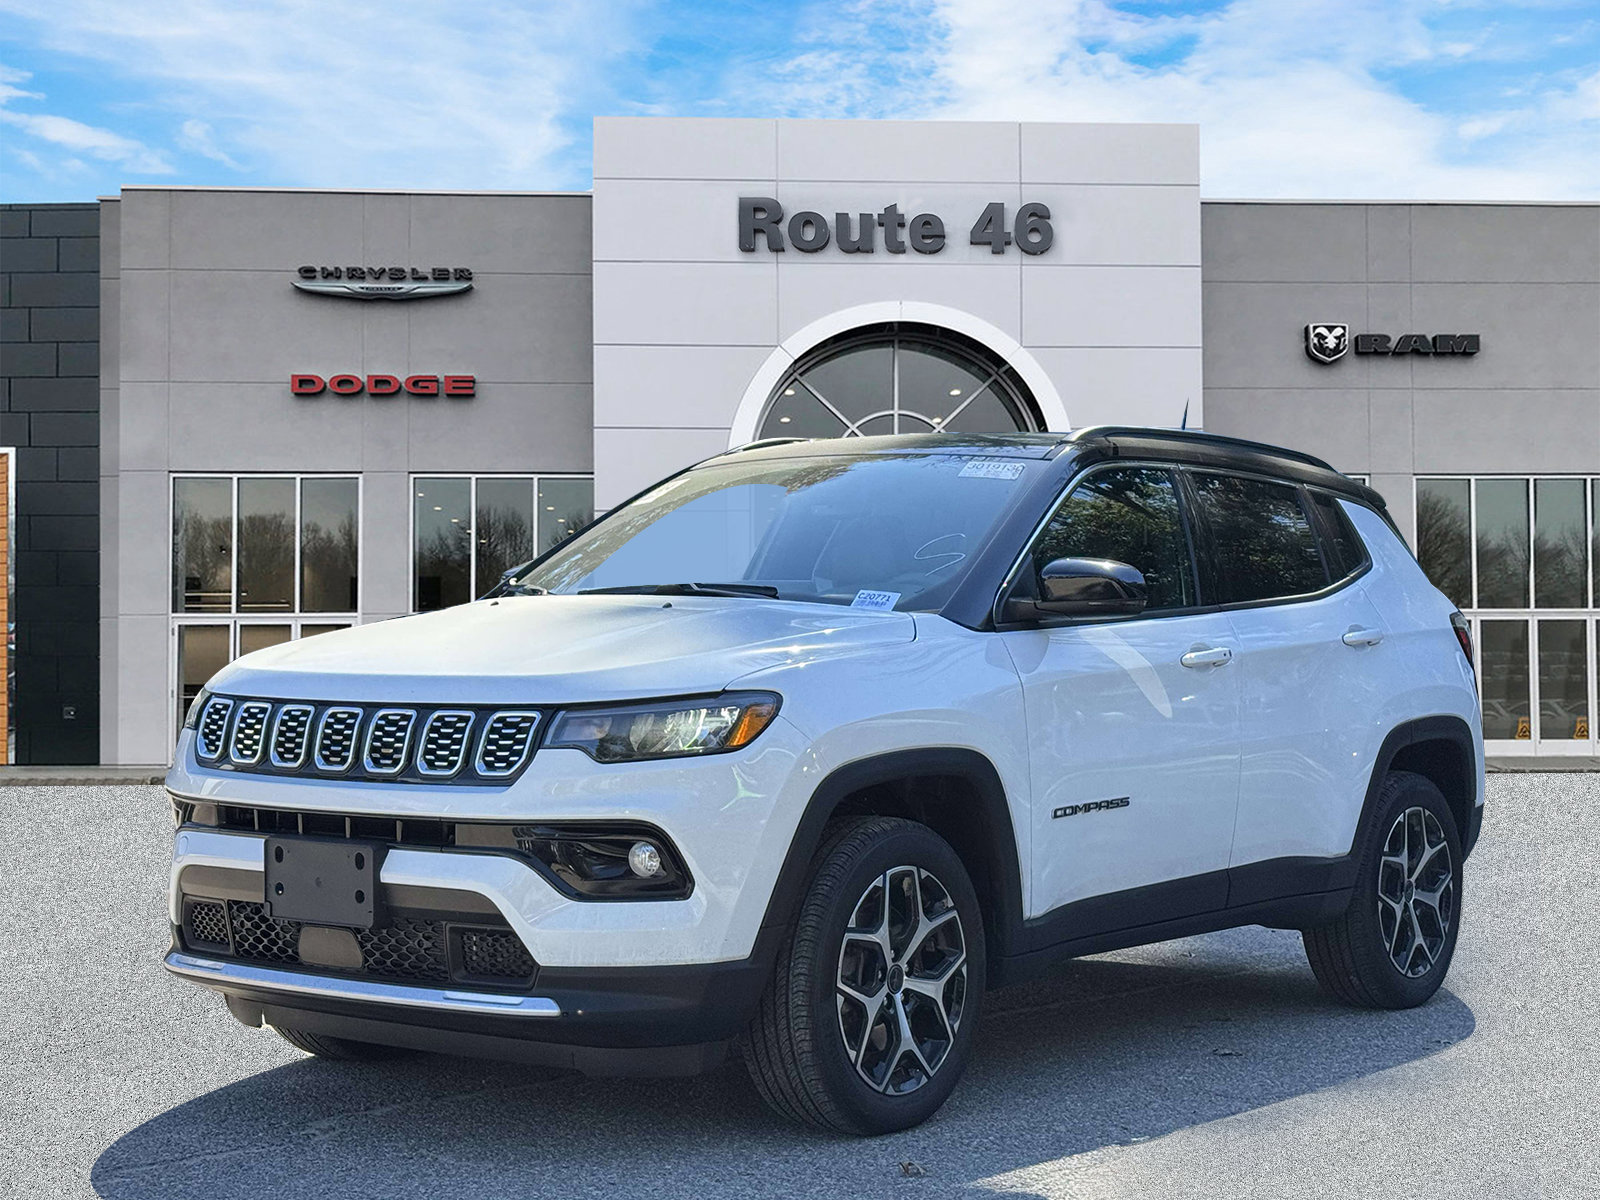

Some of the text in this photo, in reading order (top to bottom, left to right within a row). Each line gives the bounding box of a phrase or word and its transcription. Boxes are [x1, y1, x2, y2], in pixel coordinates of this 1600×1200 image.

[738, 197, 1054, 255] Route 46
[298, 265, 473, 280] CHRYSLER
[1354, 333, 1480, 356] RAM
[291, 374, 476, 396] DODGE
[857, 592, 891, 602] C20771
[1051, 796, 1130, 819] COMPASS
